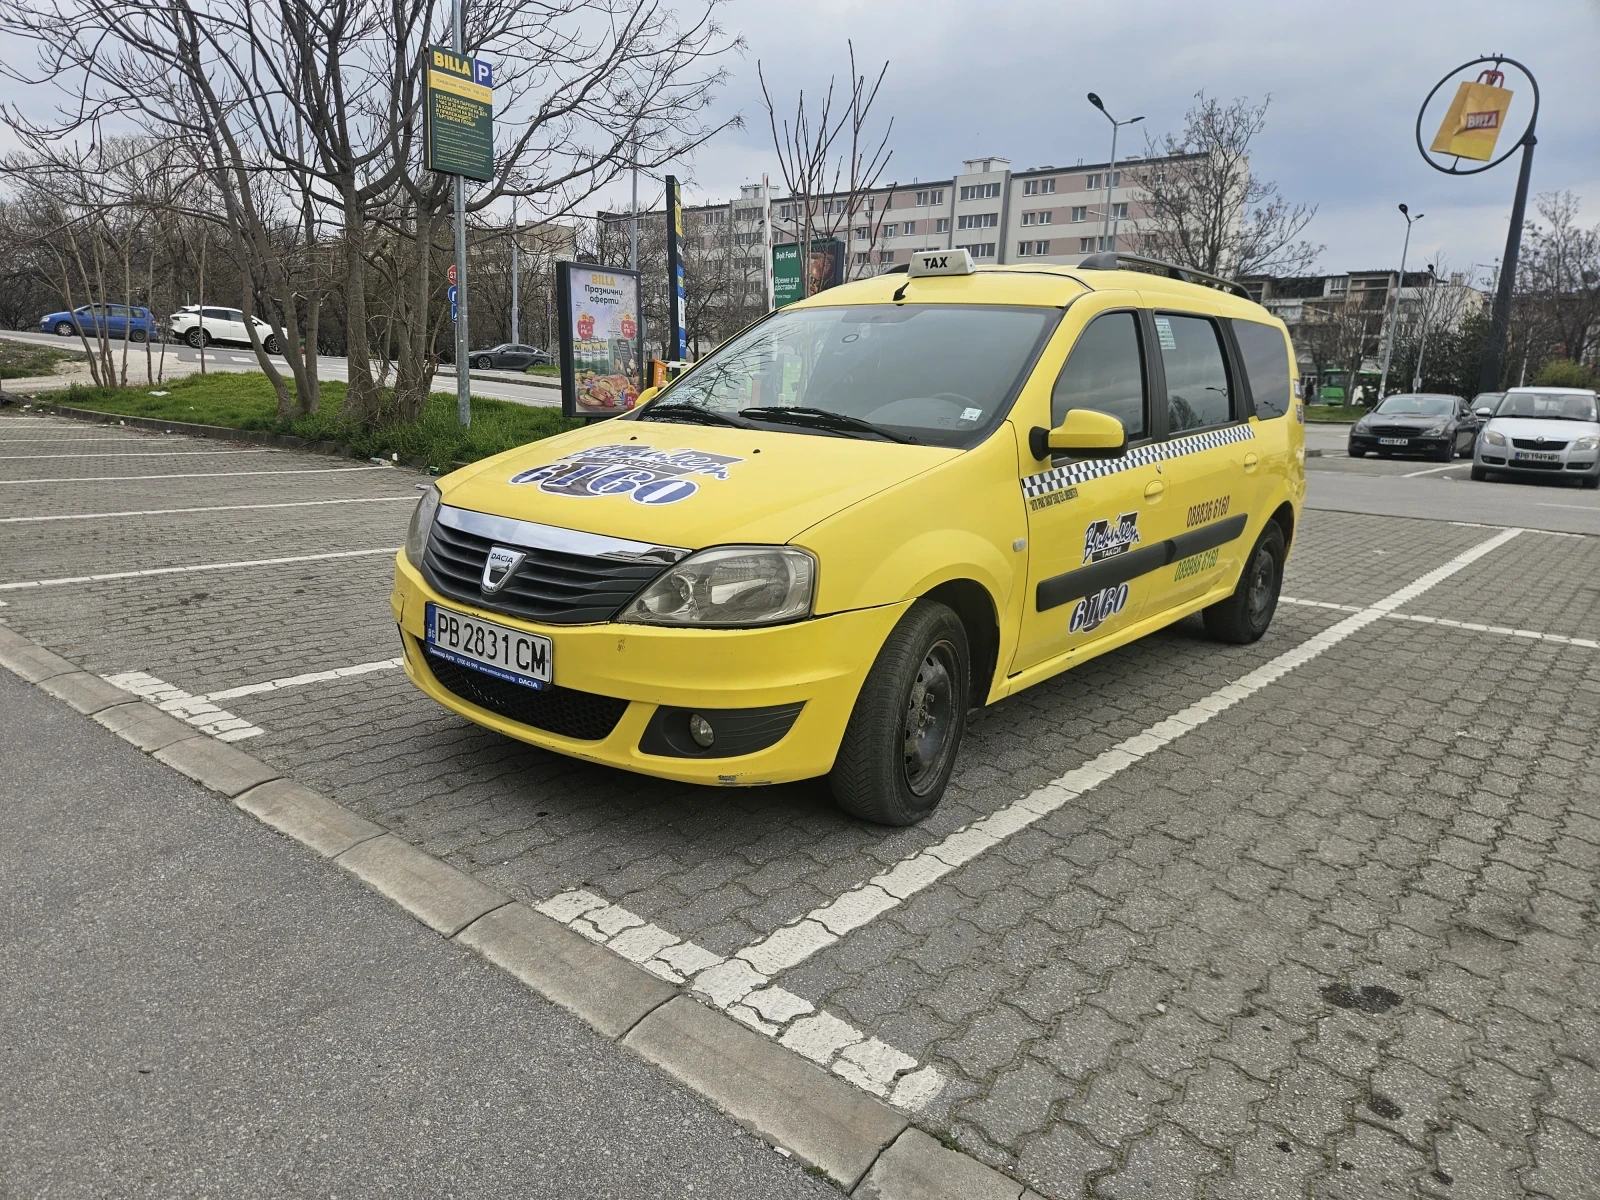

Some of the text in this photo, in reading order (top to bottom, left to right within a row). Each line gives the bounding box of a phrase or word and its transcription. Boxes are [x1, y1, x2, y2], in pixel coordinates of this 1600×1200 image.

[434, 51, 472, 76] BILLA
[477, 64, 489, 82] P
[1466, 114, 1498, 128] BILLA
[786, 250, 796, 258] Food
[591, 274, 616, 287] BILLA
[774, 276, 790, 286] Време
[584, 284, 623, 296] Празнични
[590, 295, 619, 305] оферти
[508, 463, 700, 506] 6160
[1213, 494, 1230, 519] 6160
[491, 552, 514, 564] DACIA
[1102, 547, 1122, 558] ТАКСИ
[1201, 548, 1220, 571] 6160
[1068, 584, 1129, 634] 6160
[428, 628, 436, 638] BG
[518, 678, 538, 689] DACIA
